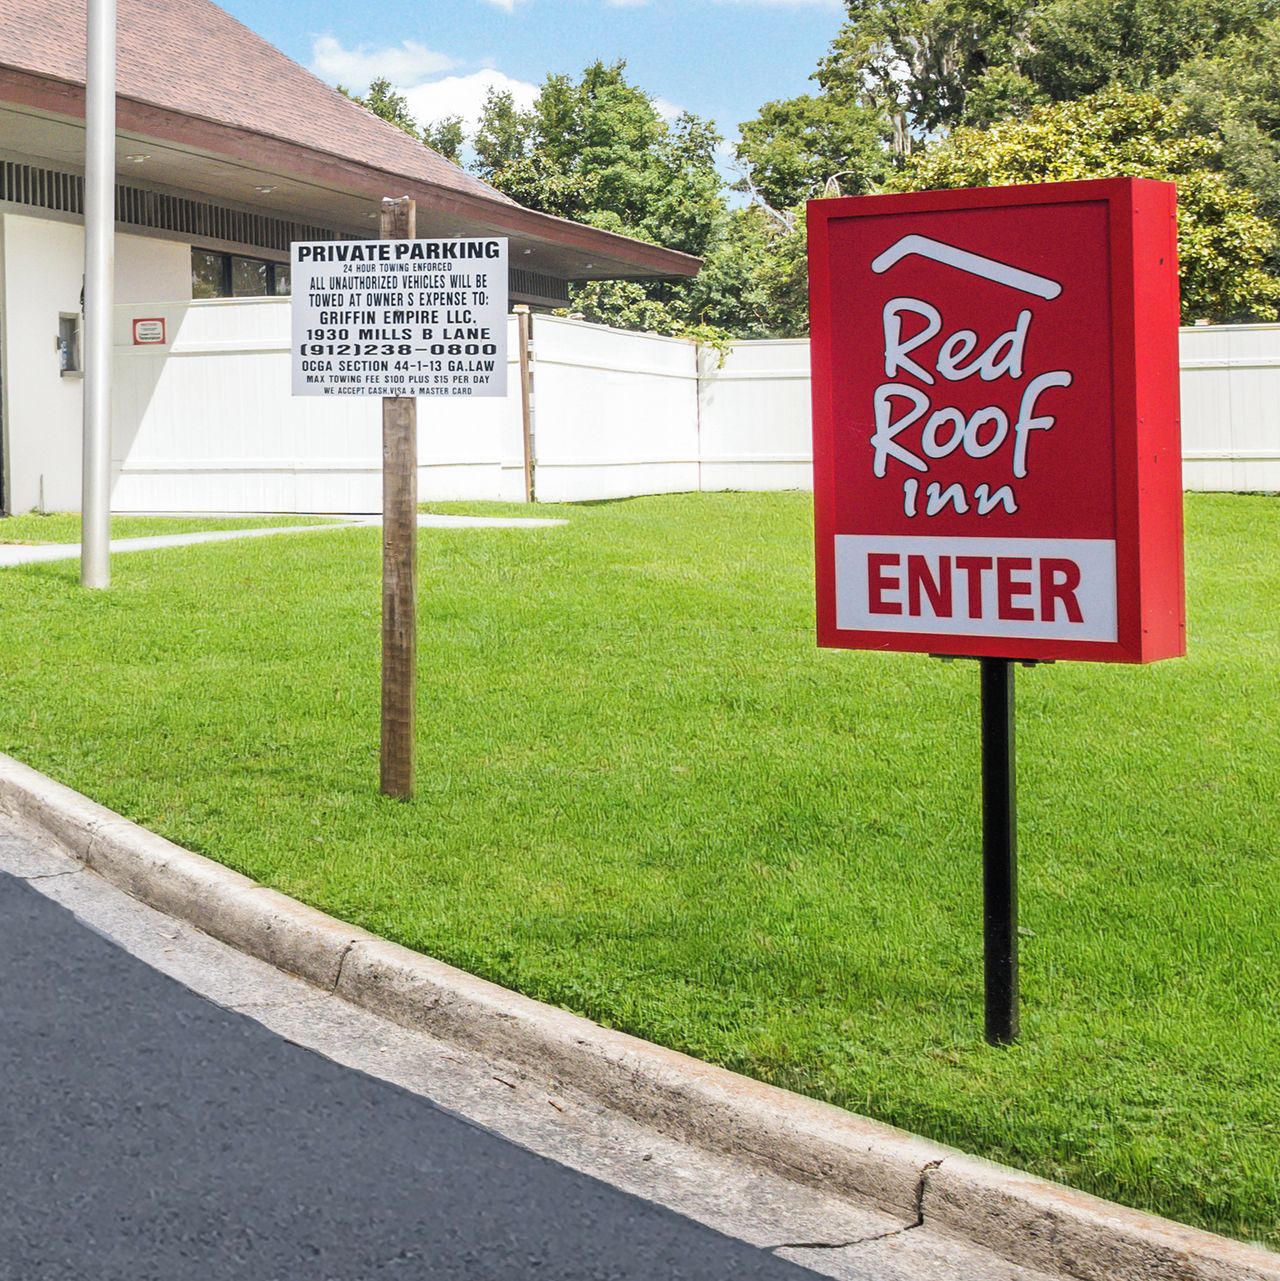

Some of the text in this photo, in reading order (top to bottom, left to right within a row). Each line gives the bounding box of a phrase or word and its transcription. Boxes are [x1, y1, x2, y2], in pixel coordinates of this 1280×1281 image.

[299, 242, 499, 262] PRIVATE PARKING
[344, 263, 452, 272] 24 HOUR TOWING ENFORCED
[310, 274, 488, 290] ALL UNAUTHORIZED VEHICLES WILL BE
[309, 294, 344, 307] TOWED
[350, 294, 362, 306] AT
[420, 292, 467, 306] EXPENSE
[472, 292, 489, 305] TO:
[320, 310, 477, 324] GRIFFIN EMPIRE LLC.
[307, 328, 491, 340] 1930 MILLS B LANE
[882, 297, 1033, 385] Red
[301, 344, 497, 356] (912)238-0800
[302, 361, 333, 371] OCGA
[339, 361, 389, 371] SECTION
[395, 361, 442, 371] 44-1-13
[307, 375, 325, 383] MAX
[329, 375, 362, 383] TOWING
[324, 387, 336, 395] WE
[410, 387, 415, 395] &
[869, 370, 1073, 479] Roof
[867, 552, 1084, 623] ENTER
